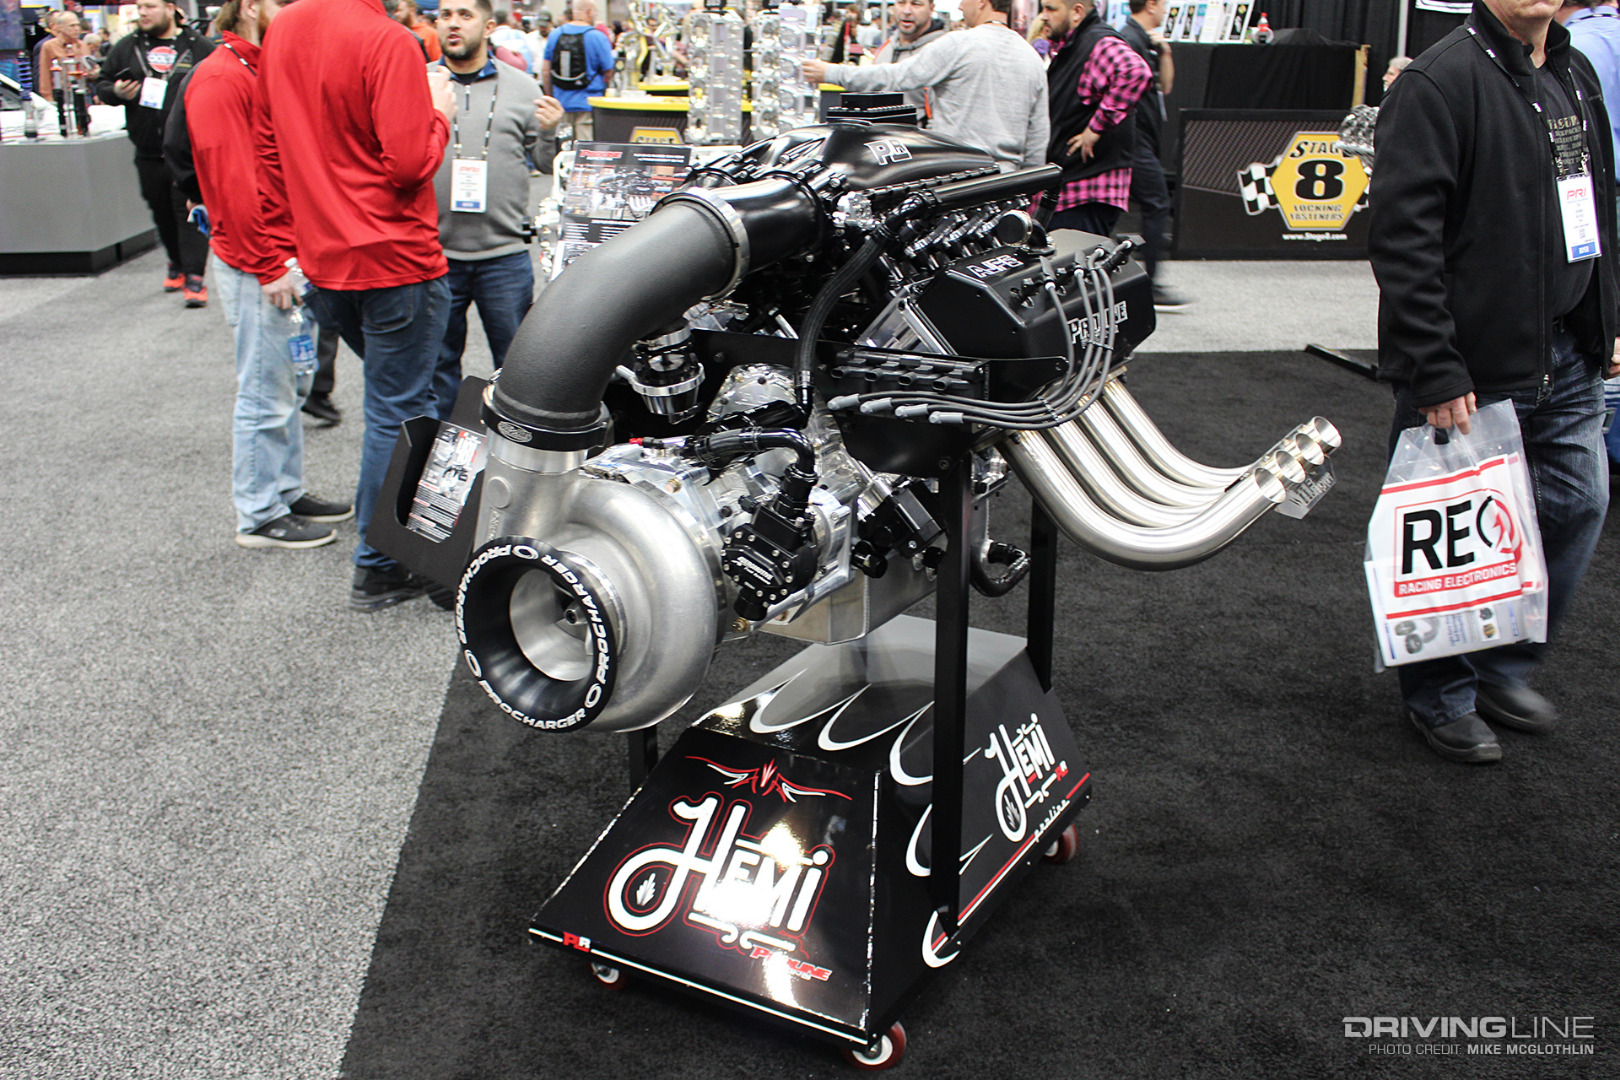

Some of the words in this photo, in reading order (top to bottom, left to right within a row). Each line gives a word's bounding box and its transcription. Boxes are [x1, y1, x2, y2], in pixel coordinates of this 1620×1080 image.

[1295, 159, 1345, 202] 8
[1566, 187, 1587, 200] PRI
[1290, 213, 1344, 221] FASTENERS
[1293, 204, 1343, 212] LOCKING
[1399, 579, 1443, 595] RACING
[1444, 562, 1517, 588] ELECTRONICS
[541, 554, 610, 684] PROCHARGER
[478, 680, 587, 730] PROCHARGER
